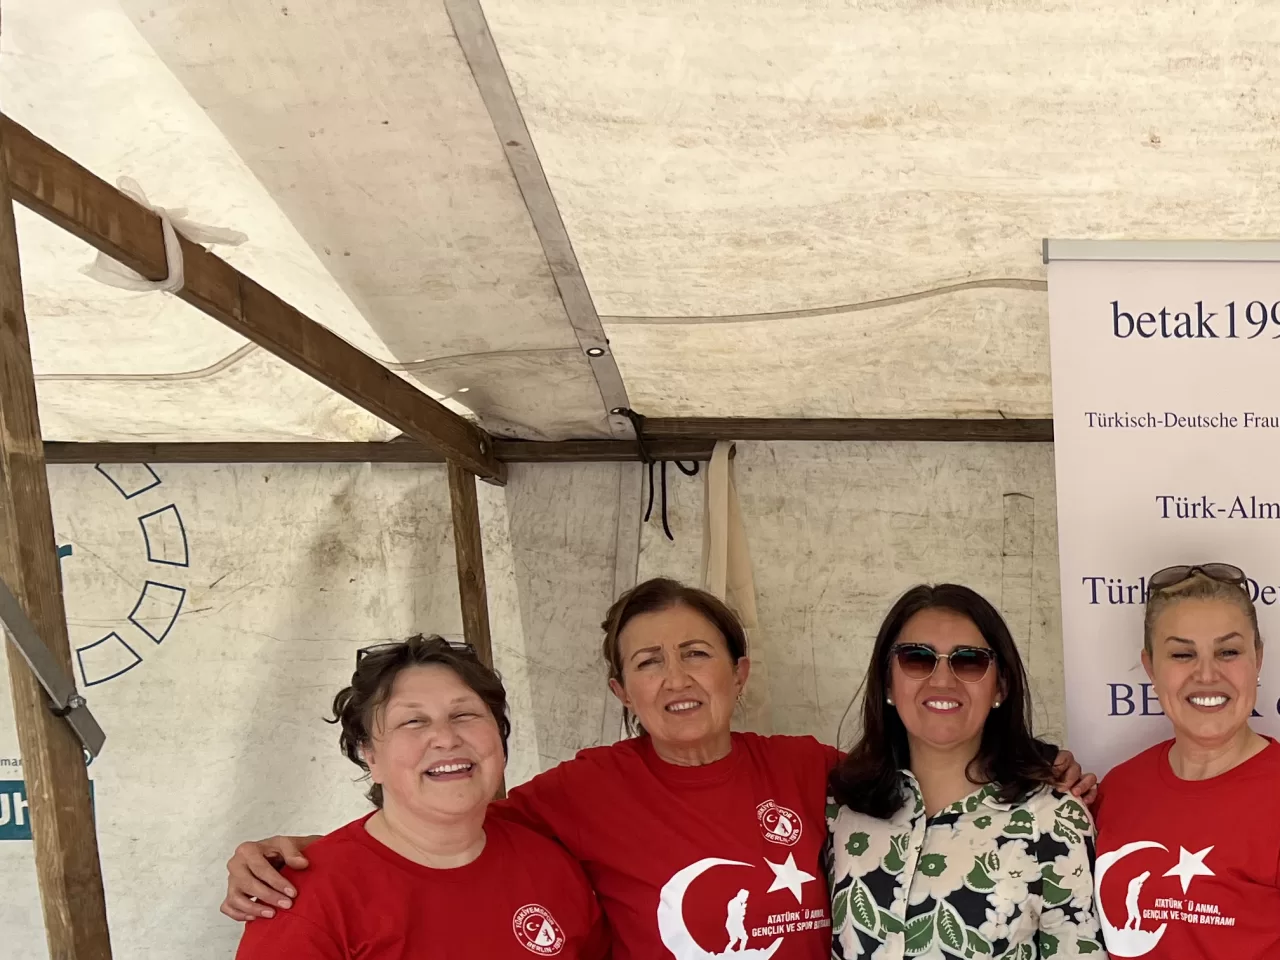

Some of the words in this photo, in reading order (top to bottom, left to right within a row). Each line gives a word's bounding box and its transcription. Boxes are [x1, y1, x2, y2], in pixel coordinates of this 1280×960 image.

[1084, 411, 1238, 429] Türkisch-Deutsche
[767, 911, 801, 925] ATATÜRK
[1169, 910, 1180, 920] VE
[1199, 915, 1236, 927] BAYRAMI
